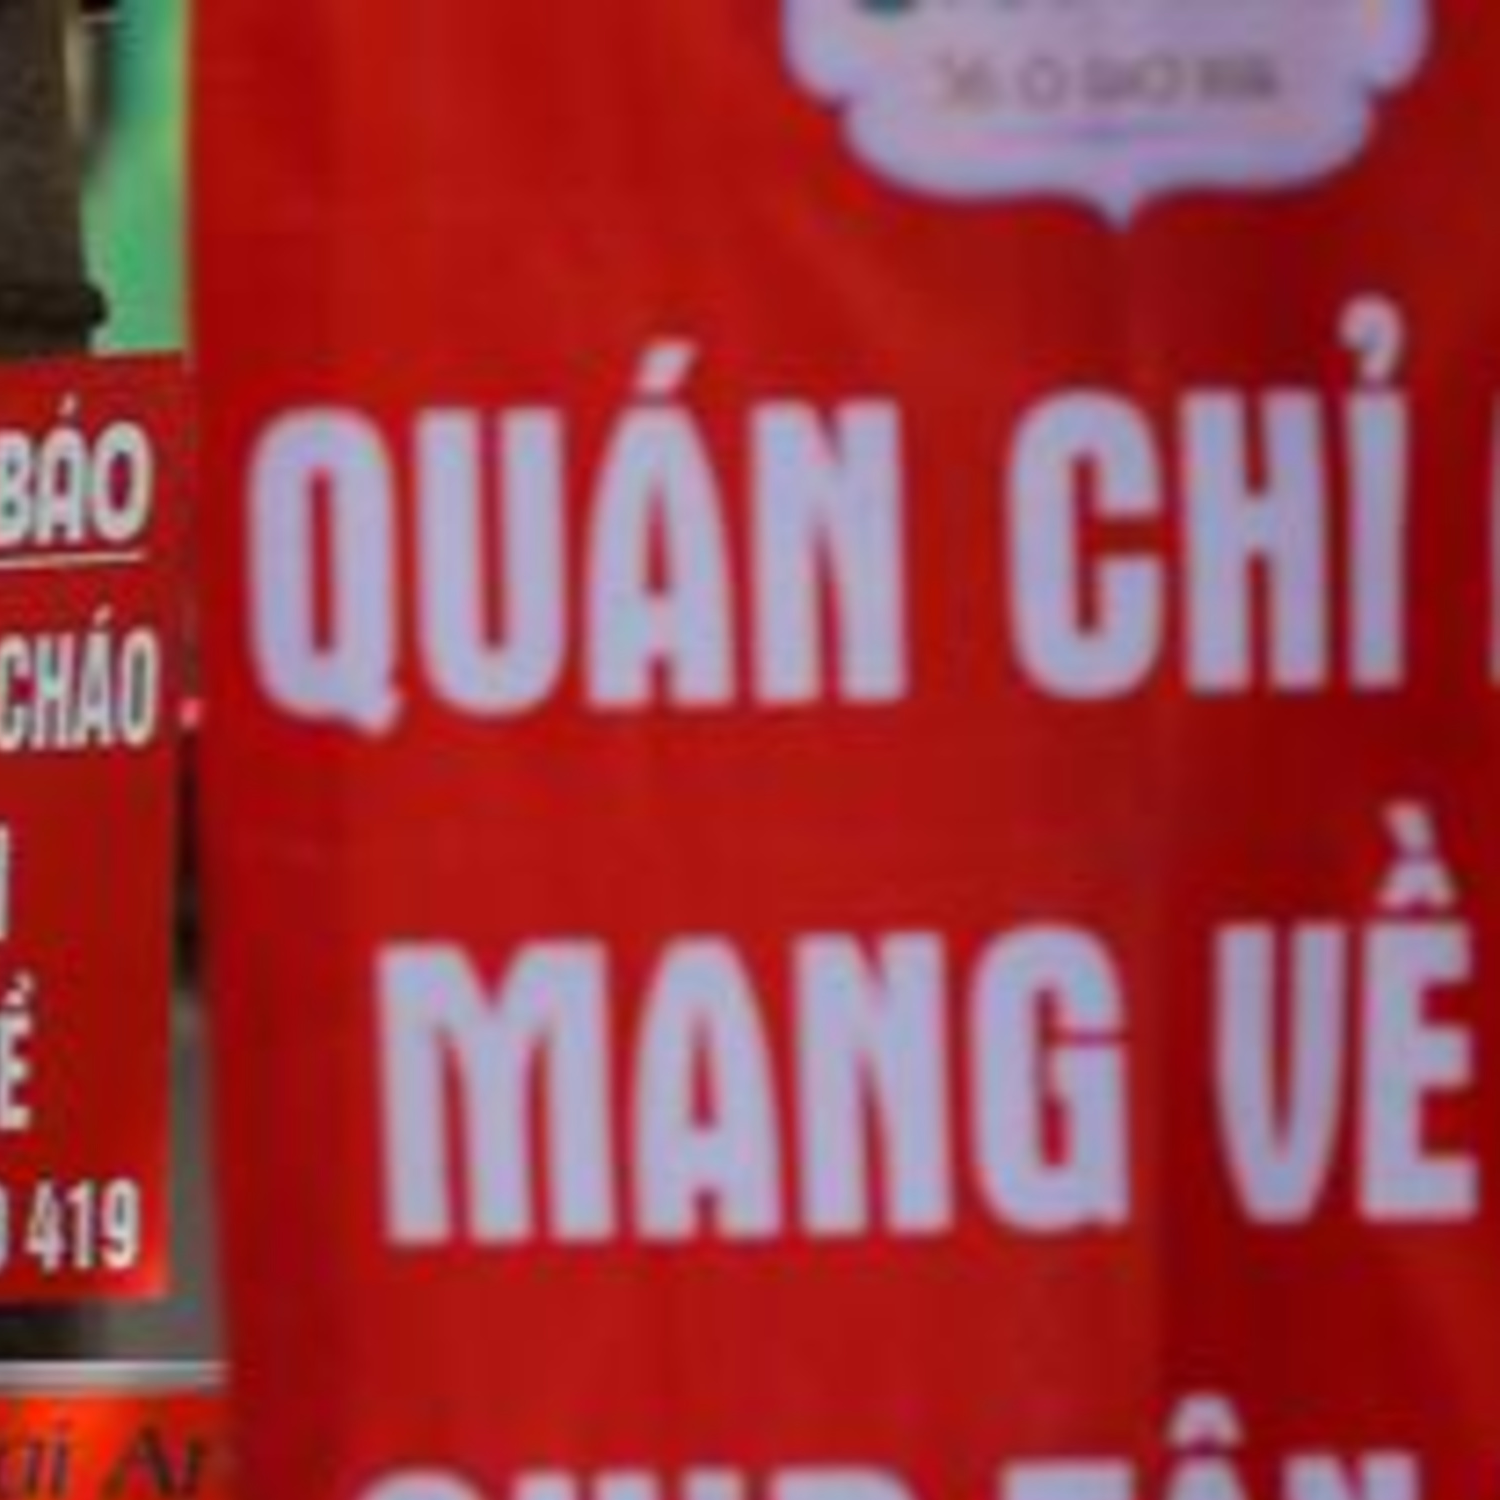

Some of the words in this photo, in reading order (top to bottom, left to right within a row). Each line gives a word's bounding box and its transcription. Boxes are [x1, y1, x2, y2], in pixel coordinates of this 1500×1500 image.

[247, 340, 907, 733] QUÁN
[1006, 294, 1408, 698] CHỈ
[25, 1178, 140, 1271] 419
[376, 924, 1130, 1245] MANG
[1217, 802, 1477, 1221] VỀ
